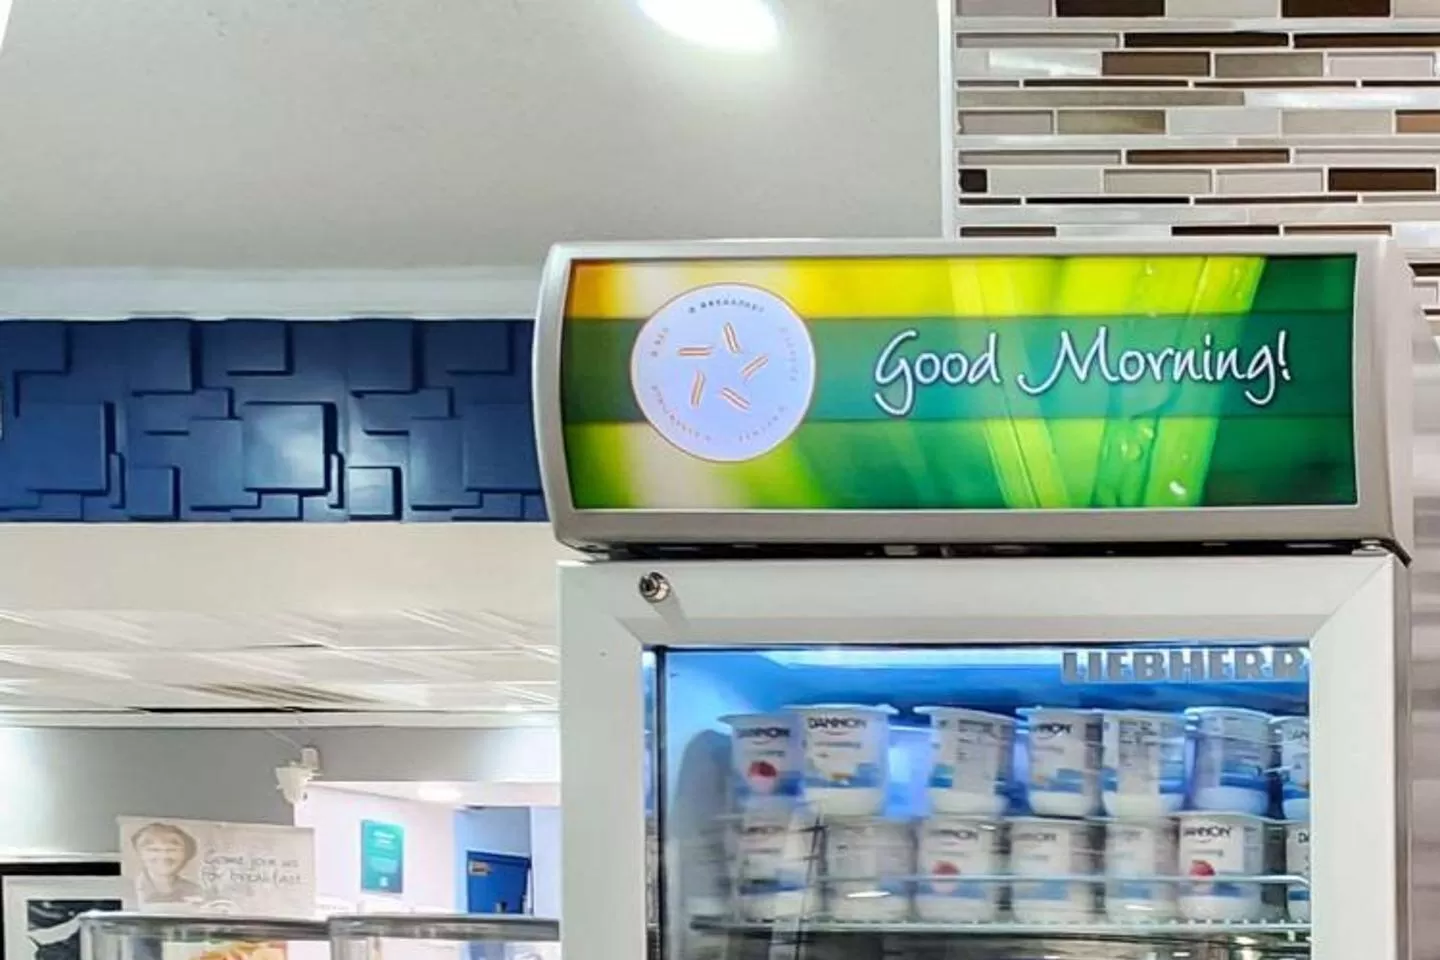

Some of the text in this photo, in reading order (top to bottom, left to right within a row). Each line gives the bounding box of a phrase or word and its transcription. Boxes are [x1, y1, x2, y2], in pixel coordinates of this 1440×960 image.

[873, 329, 1002, 416] Good
[1016, 325, 1292, 406] Morning!
[1061, 649, 1306, 682] LIEBHERR
[807, 715, 867, 730] DANNON
